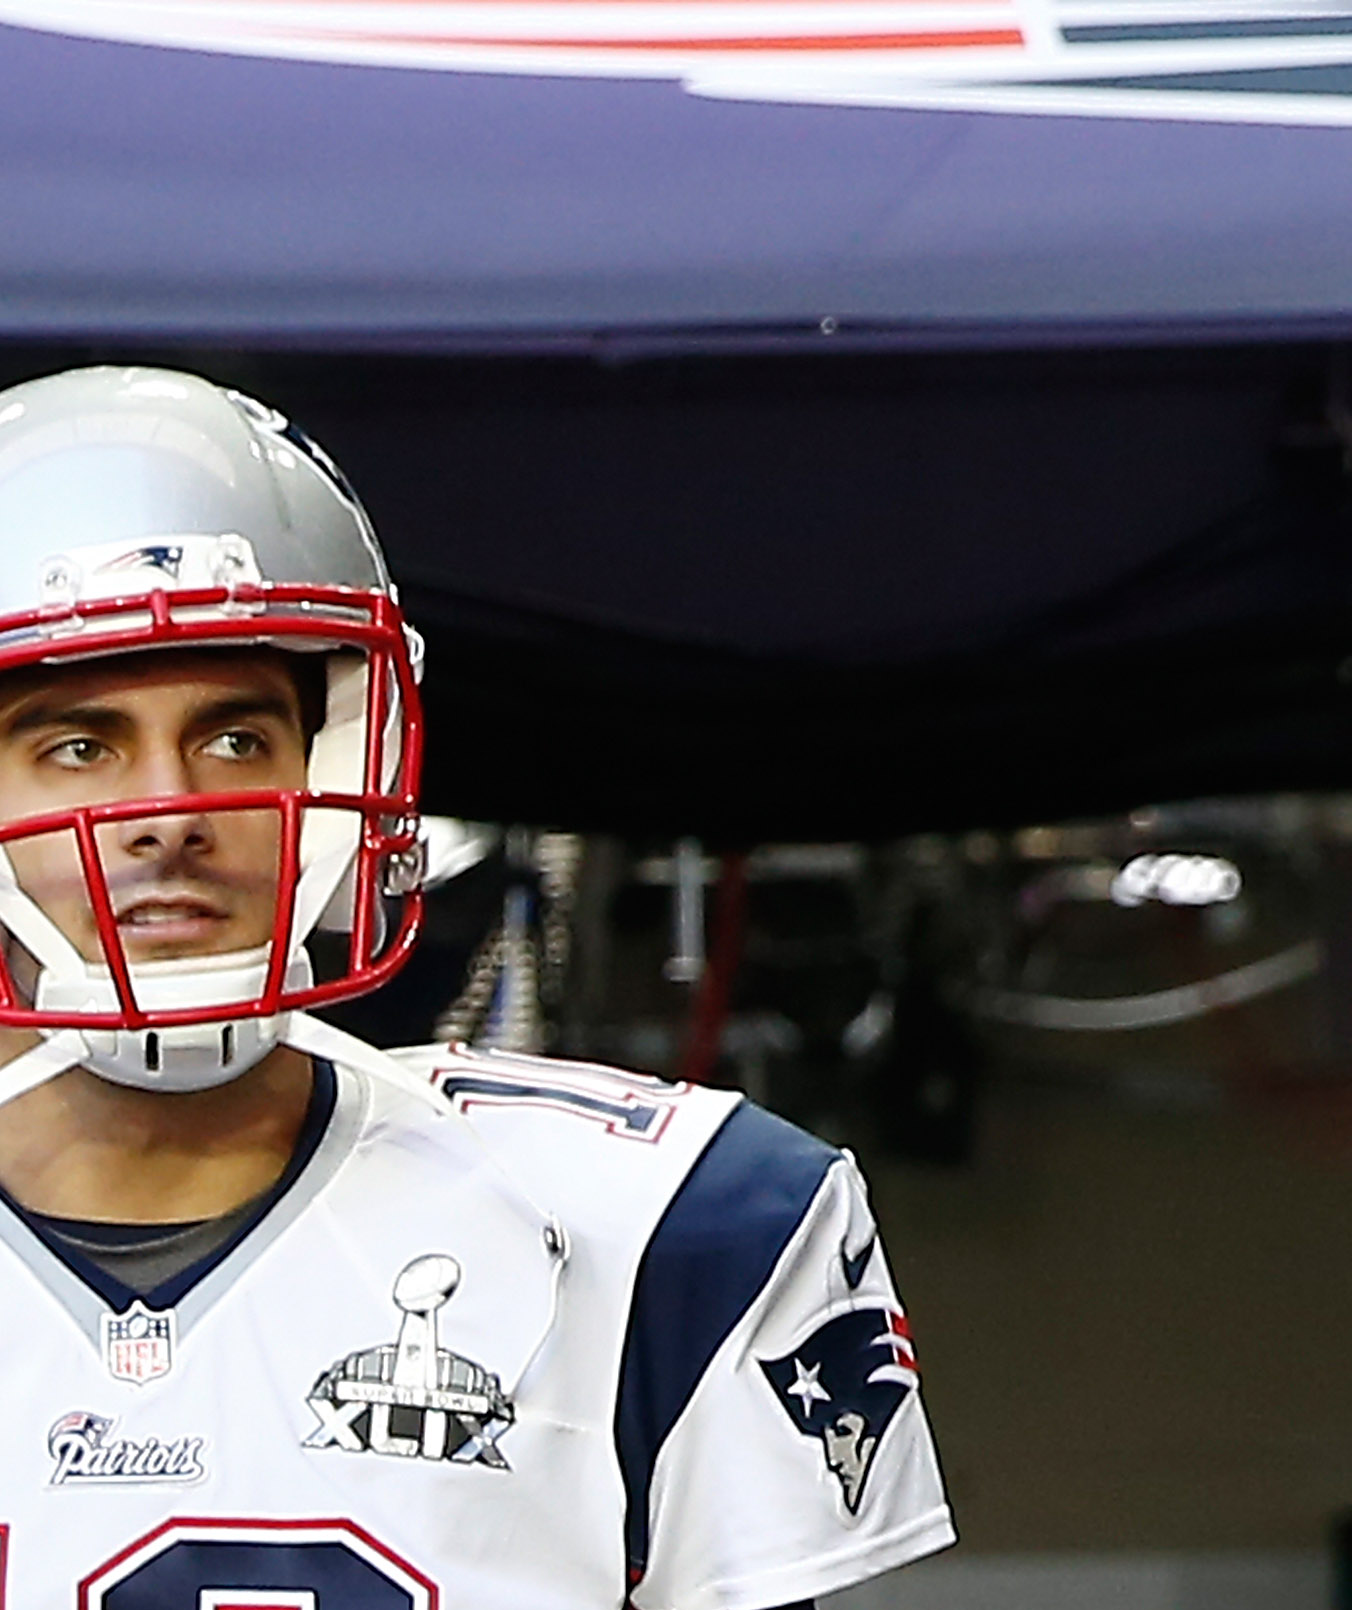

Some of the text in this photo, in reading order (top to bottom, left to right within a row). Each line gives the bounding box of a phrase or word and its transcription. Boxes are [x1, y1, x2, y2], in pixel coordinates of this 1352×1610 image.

[114, 1341, 165, 1378] NFL
[50, 1431, 205, 1485] Patriots
[301, 1398, 515, 1472] XLIX
